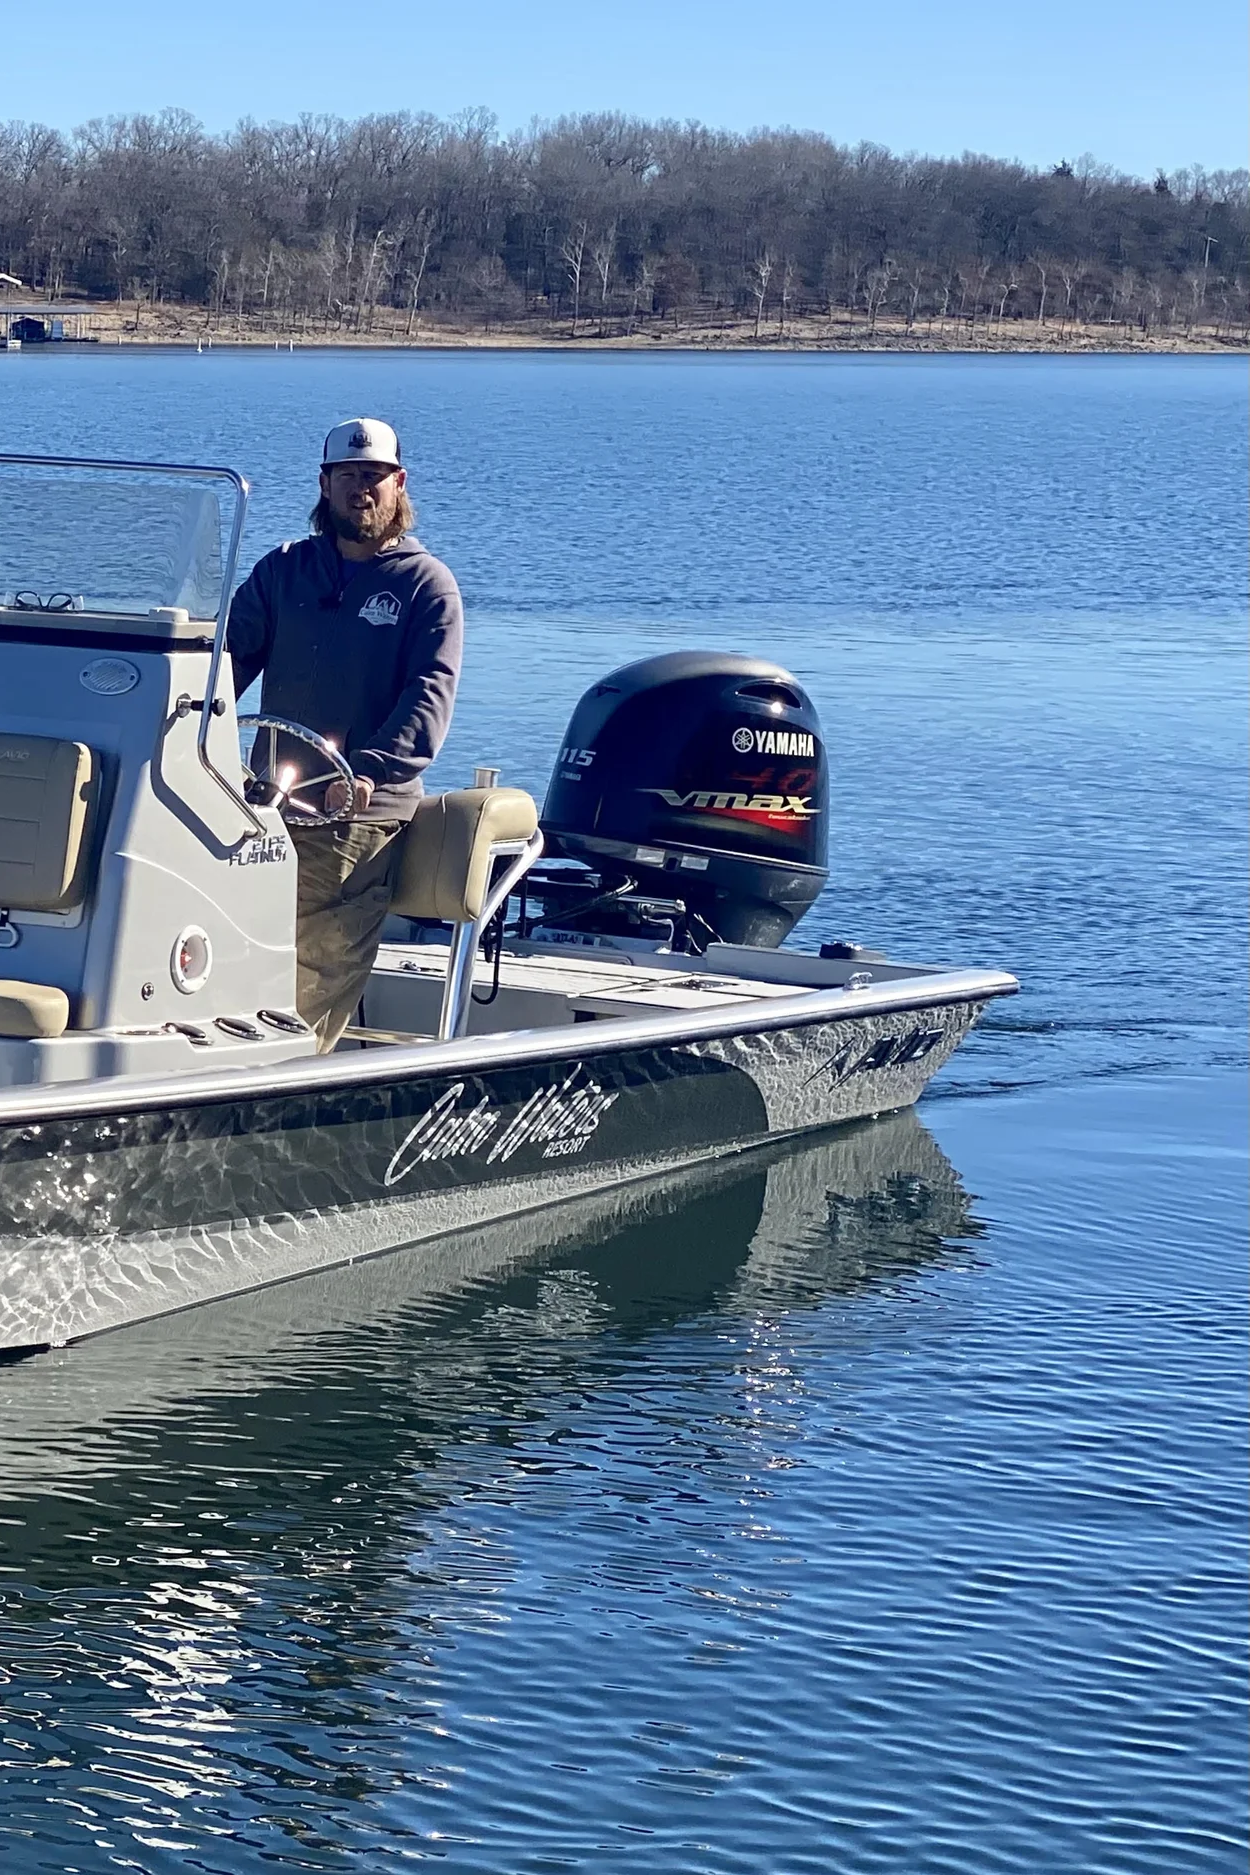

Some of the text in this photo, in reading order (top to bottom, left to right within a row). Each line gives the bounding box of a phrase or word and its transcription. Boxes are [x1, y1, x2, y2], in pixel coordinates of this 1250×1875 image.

[755, 730, 815, 757] YAMAHA
[560, 747, 597, 767] 115
[486, 1061, 620, 1165] Waters
[541, 1135, 591, 1159] RESORT
